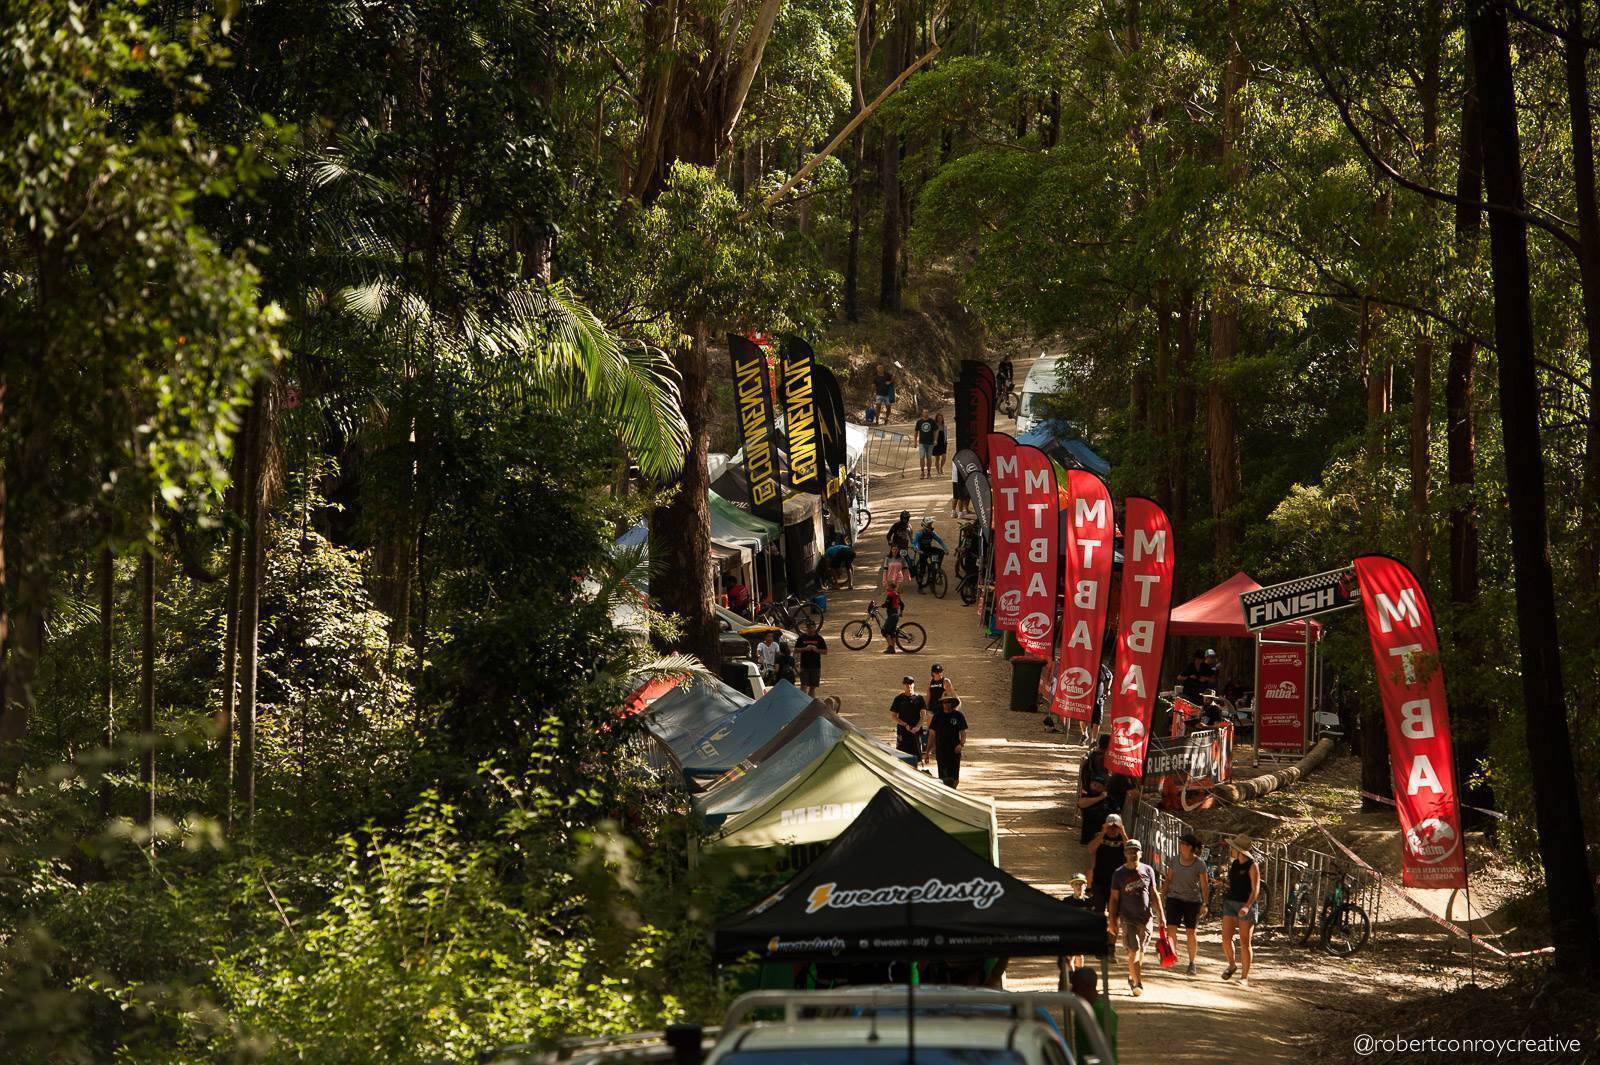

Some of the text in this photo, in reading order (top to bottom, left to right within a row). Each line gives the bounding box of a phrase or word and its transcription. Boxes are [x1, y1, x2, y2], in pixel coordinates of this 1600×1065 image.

[1250, 587, 1335, 625] FINISH
[1154, 754, 1170, 773] LIFE
[781, 802, 863, 826] MEDI
[829, 877, 1004, 910] wearelusty
[873, 936, 930, 948] @wearesty
